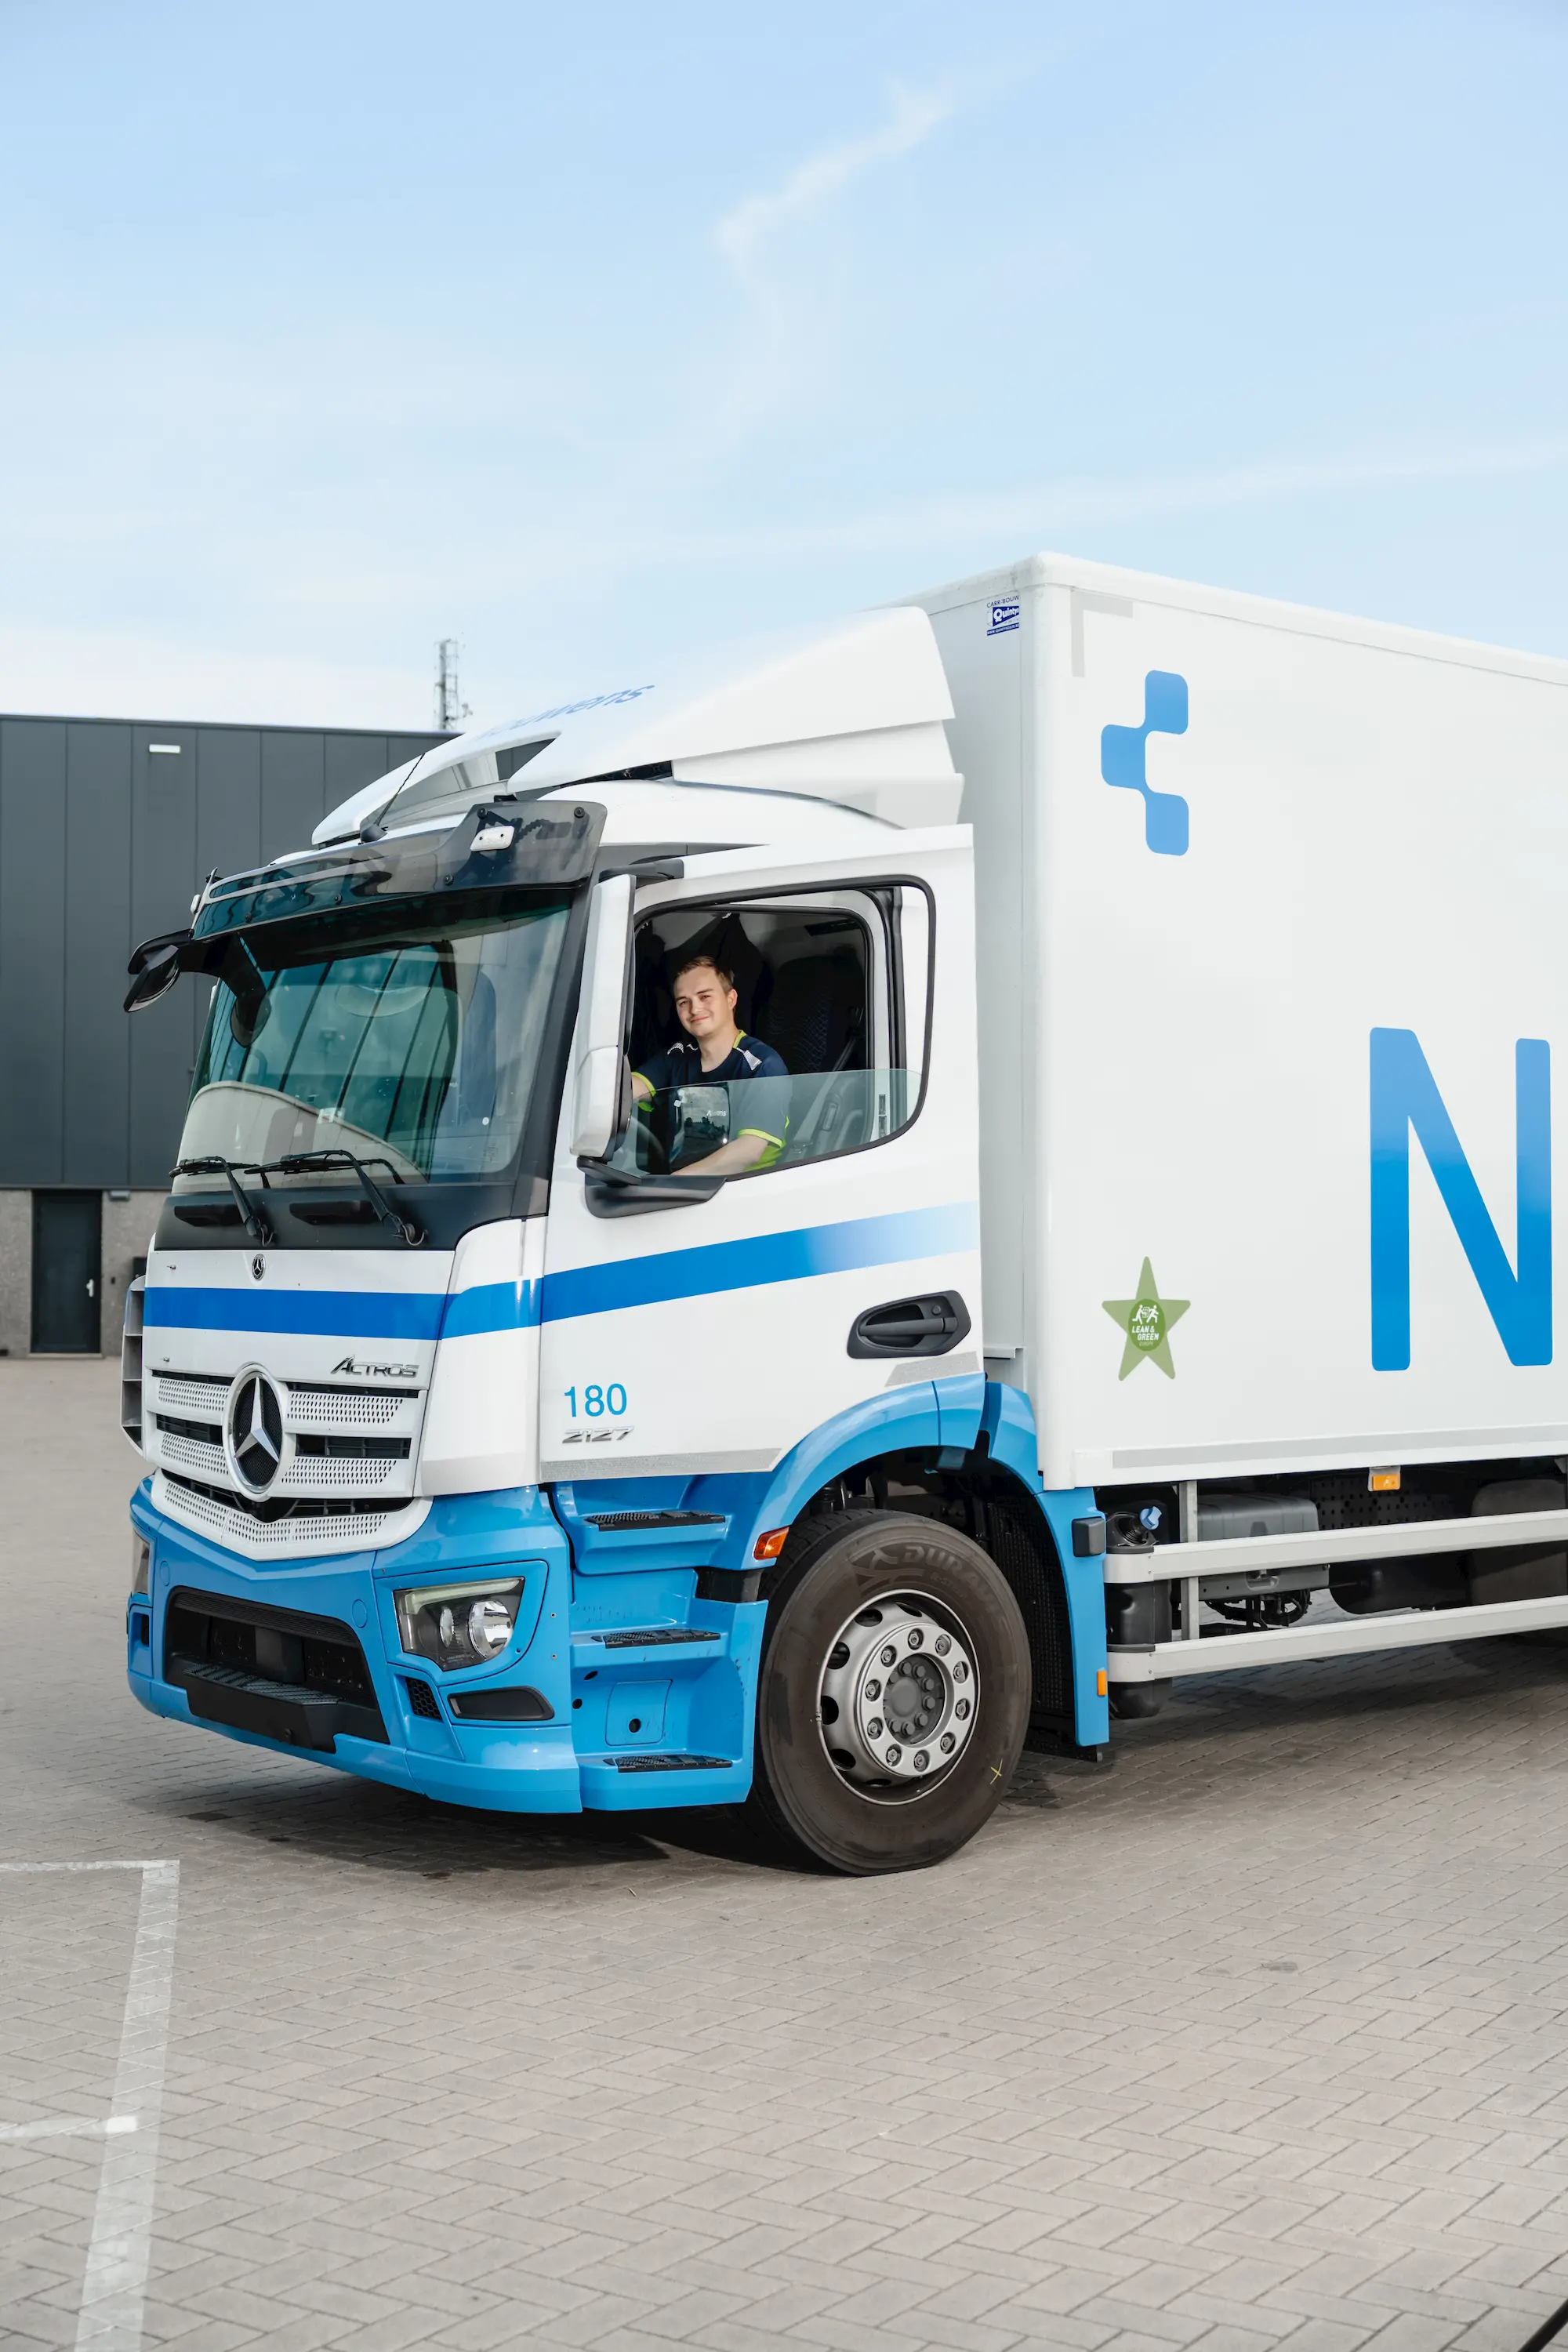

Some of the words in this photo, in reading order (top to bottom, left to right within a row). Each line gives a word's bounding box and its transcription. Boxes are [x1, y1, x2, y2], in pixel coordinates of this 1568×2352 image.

[1369, 1026, 1553, 1371] N
[1131, 1325, 1150, 1334] LEAN
[1149, 1325, 1156, 1334] &
[1137, 1333, 1160, 1341] GREEN
[564, 1383, 627, 1417] 180
[561, 1425, 635, 1444] 2127
